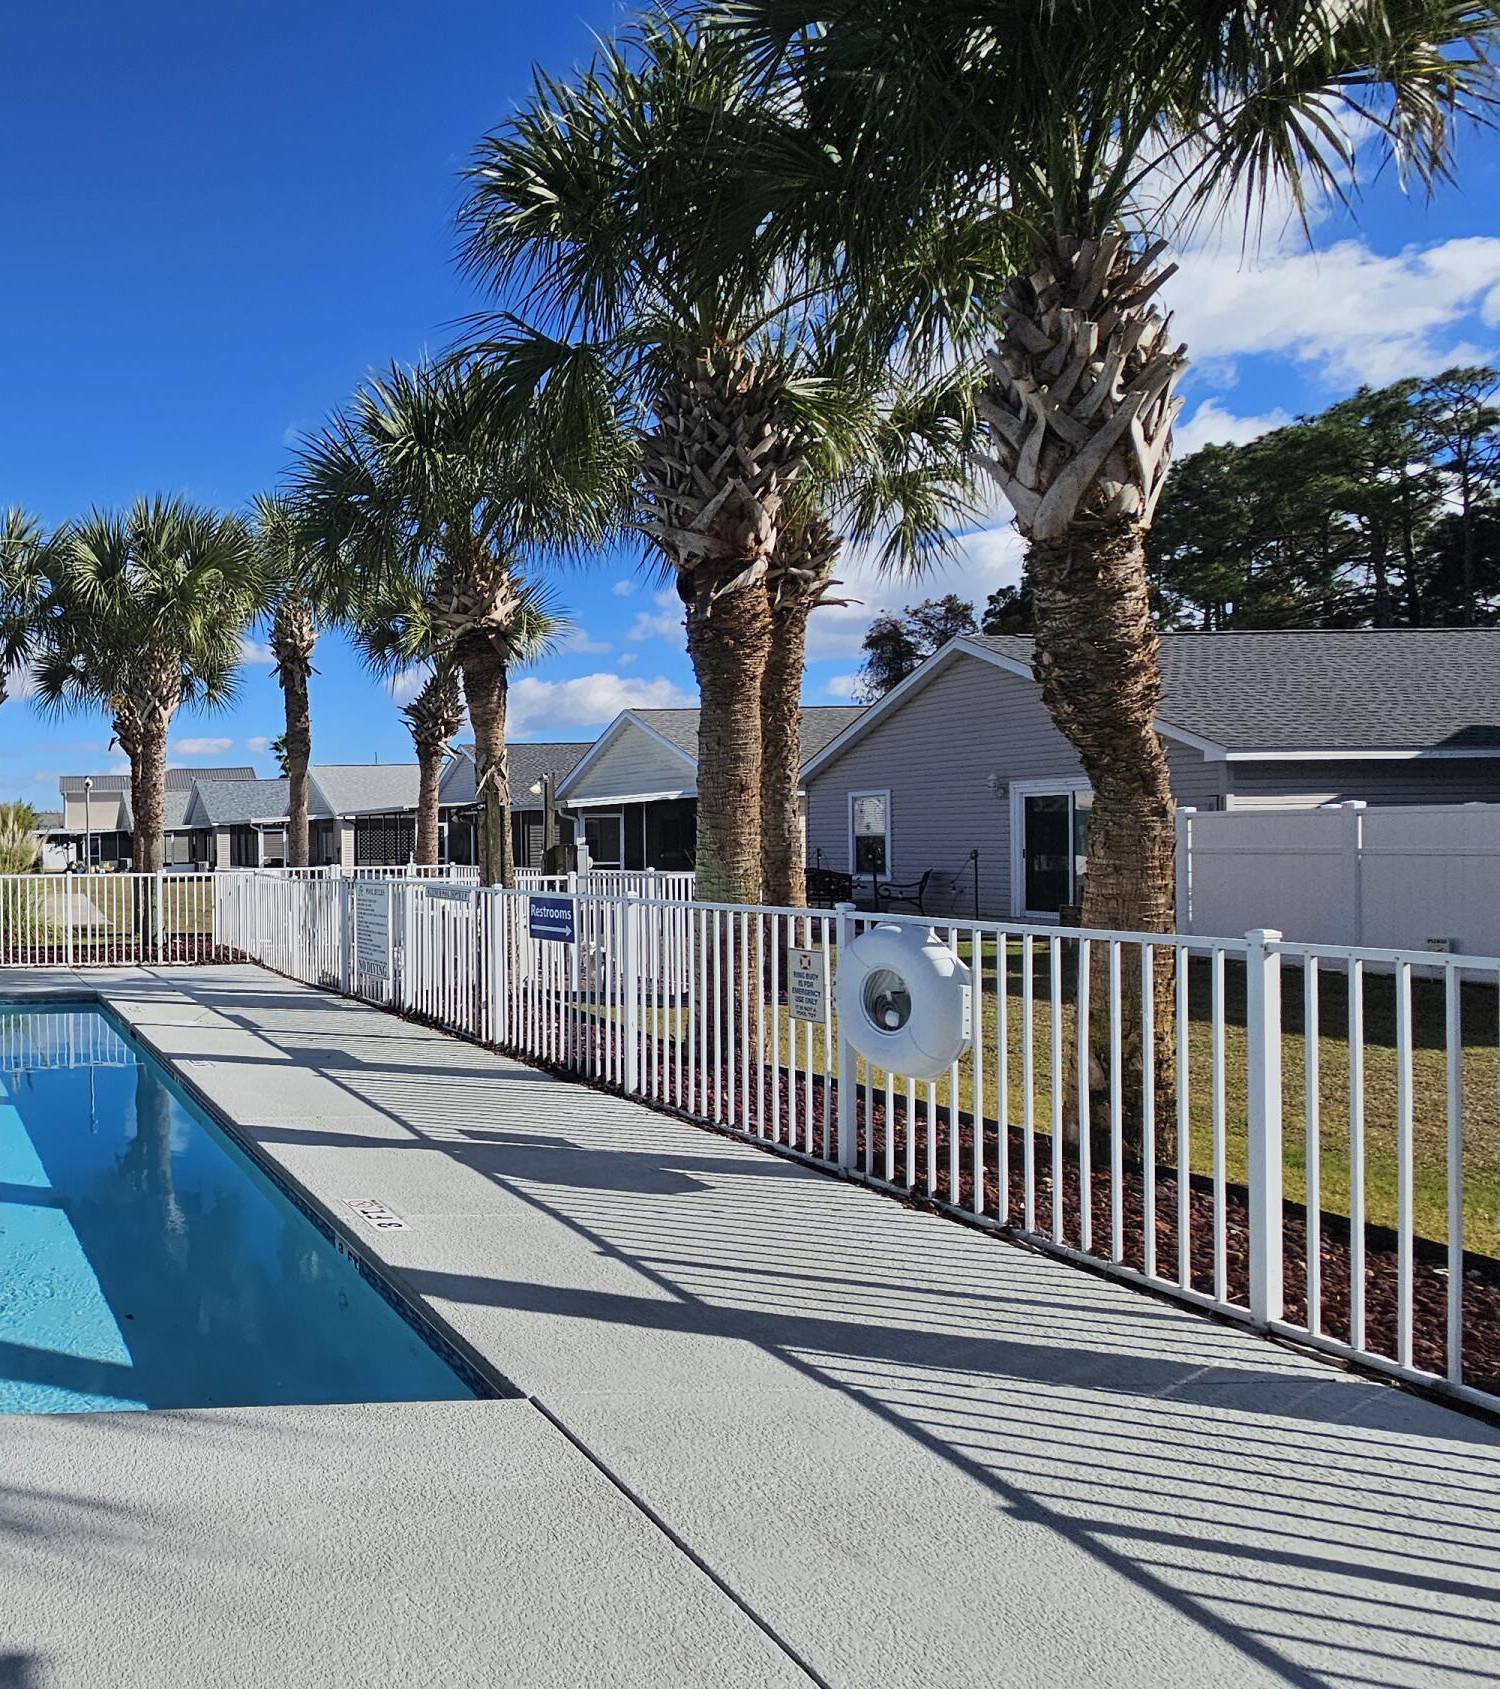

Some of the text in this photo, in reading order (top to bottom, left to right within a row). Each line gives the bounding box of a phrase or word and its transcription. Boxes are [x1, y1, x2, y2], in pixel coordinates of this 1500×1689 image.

[531, 904, 572, 920] Restrooms
[358, 959, 387, 977] NO DIVING
[792, 987, 820, 998] EMERGENCY
[361, 1210, 393, 1220] FT
